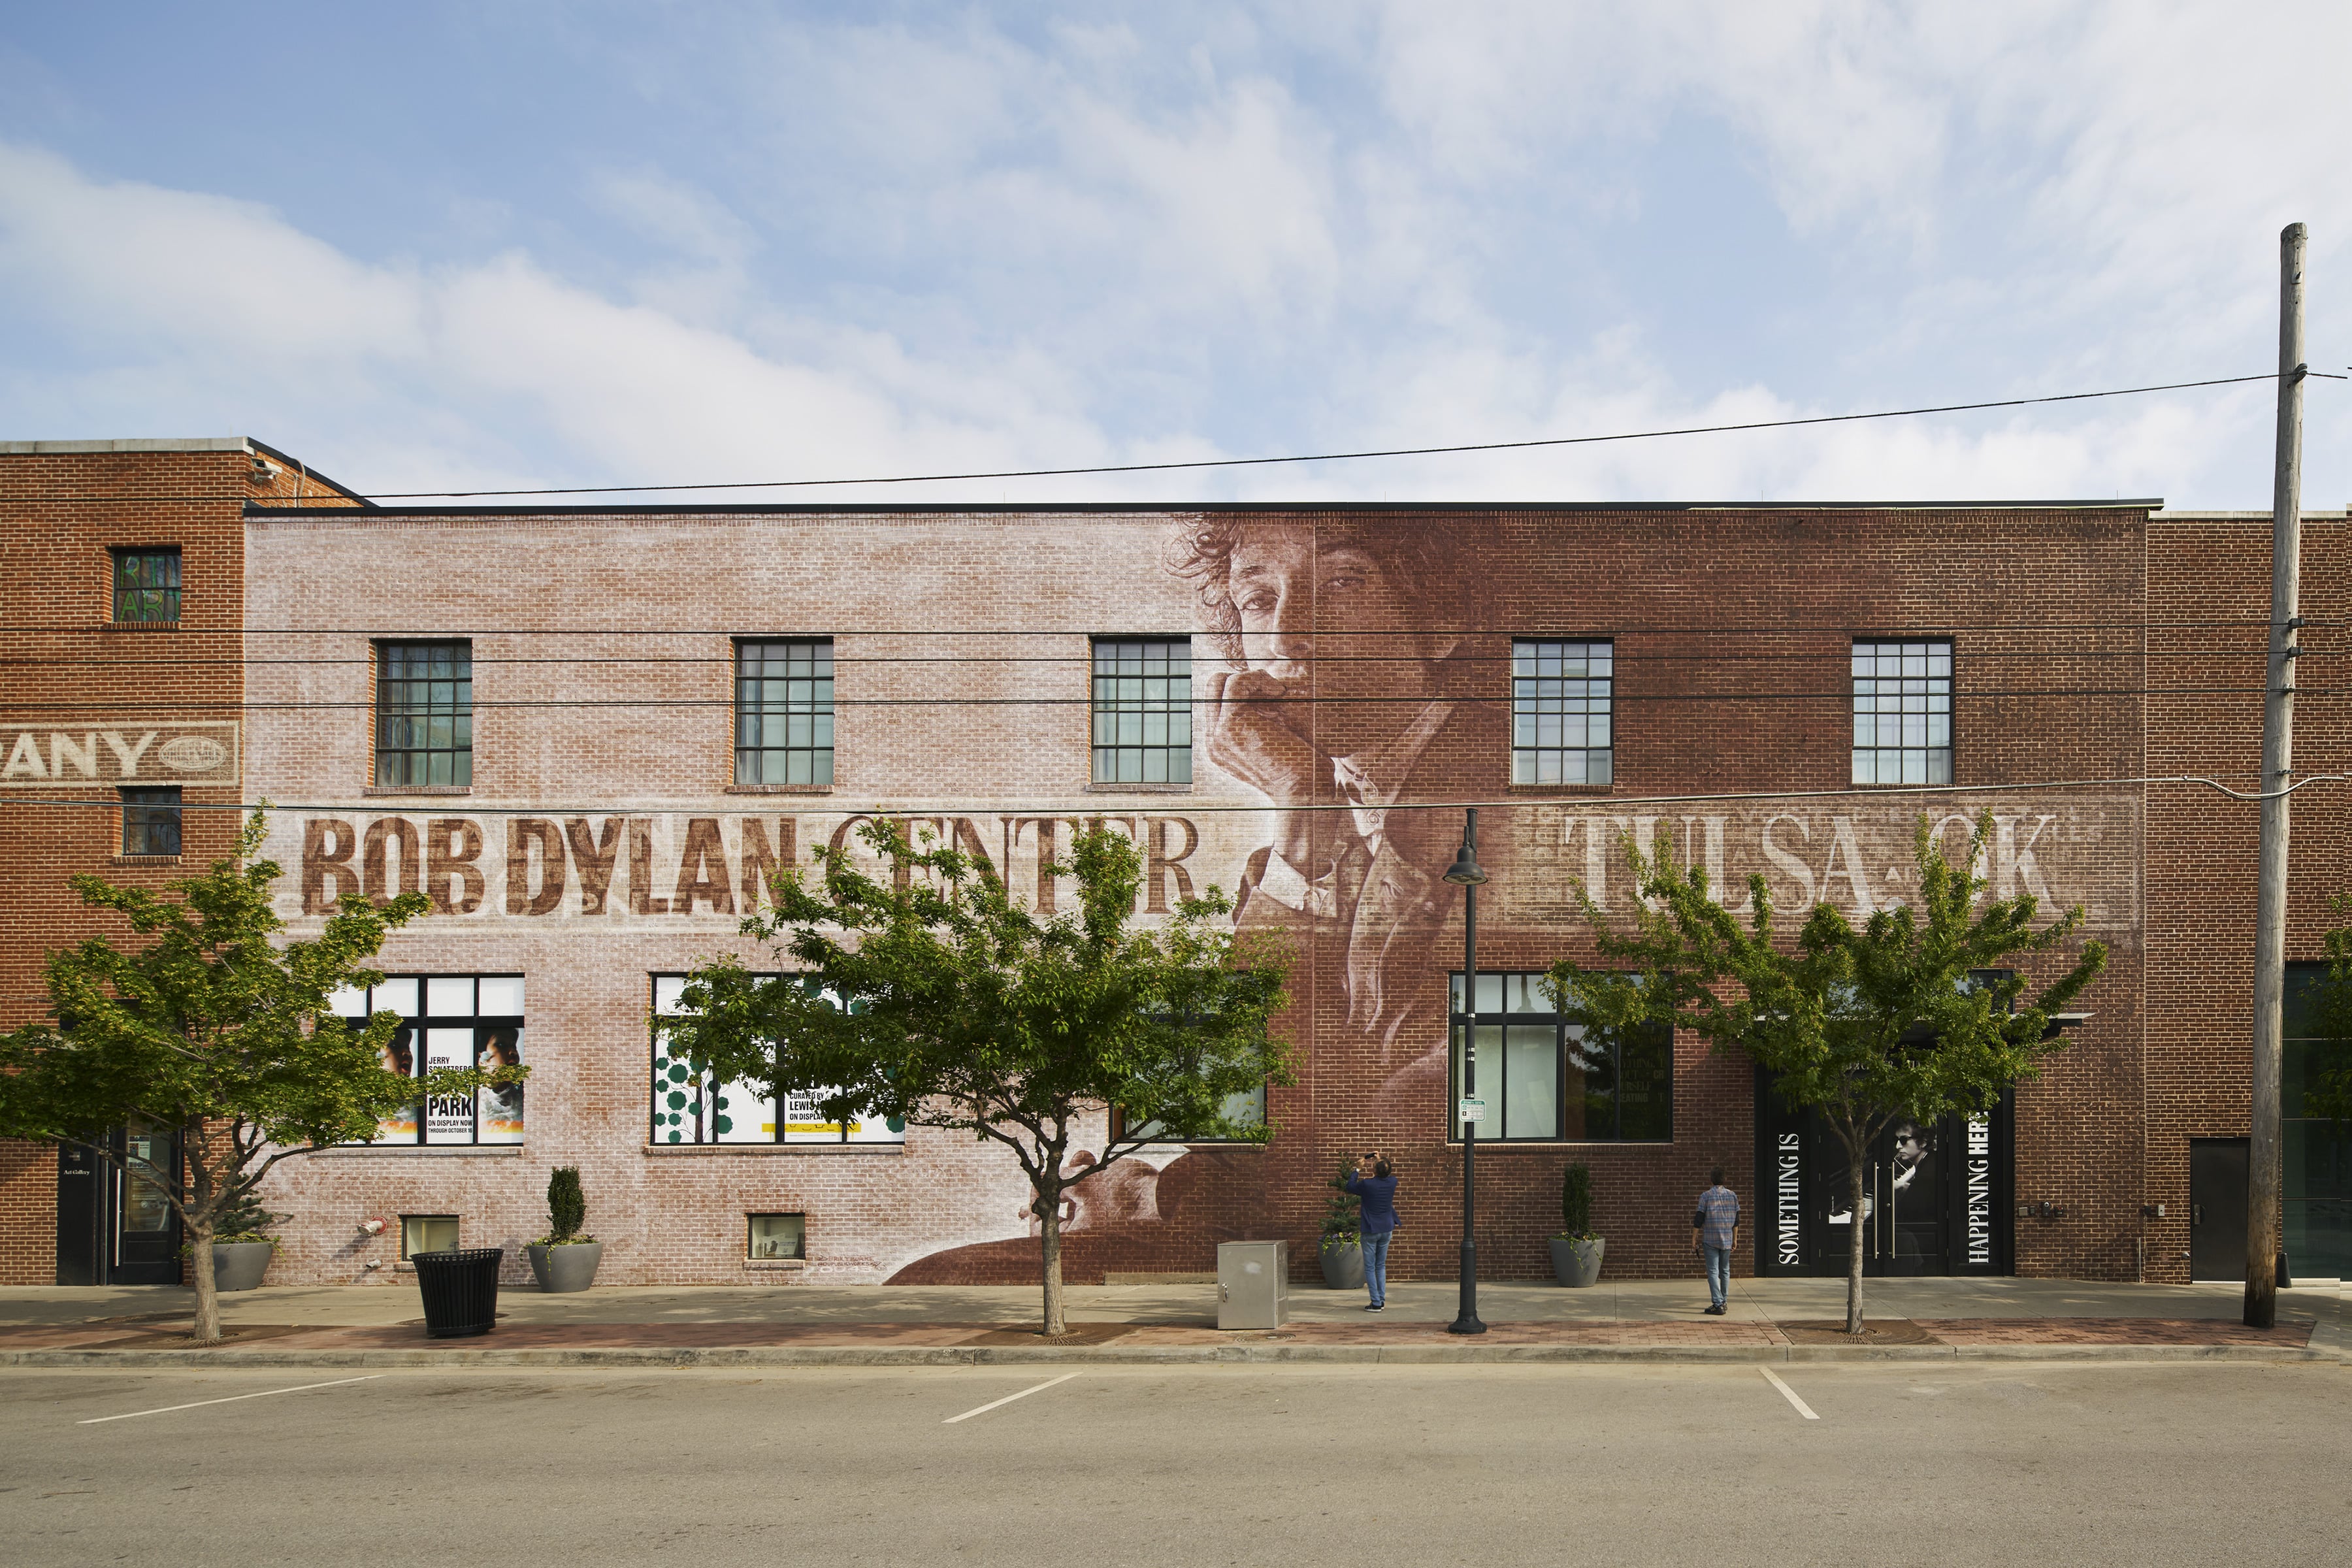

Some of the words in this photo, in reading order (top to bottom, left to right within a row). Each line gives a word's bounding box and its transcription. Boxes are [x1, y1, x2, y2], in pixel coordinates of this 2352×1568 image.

[0, 732, 159, 777] ANY
[301, 816, 486, 915] BOB
[506, 817, 796, 915] DYLAN
[1925, 813, 2065, 915] OK
[429, 1096, 472, 1117] PARK
[1778, 1133, 1799, 1152] IS
[1778, 1155, 1799, 1265] SOMETHING
[1968, 1159, 1989, 1264] HAPPENING
